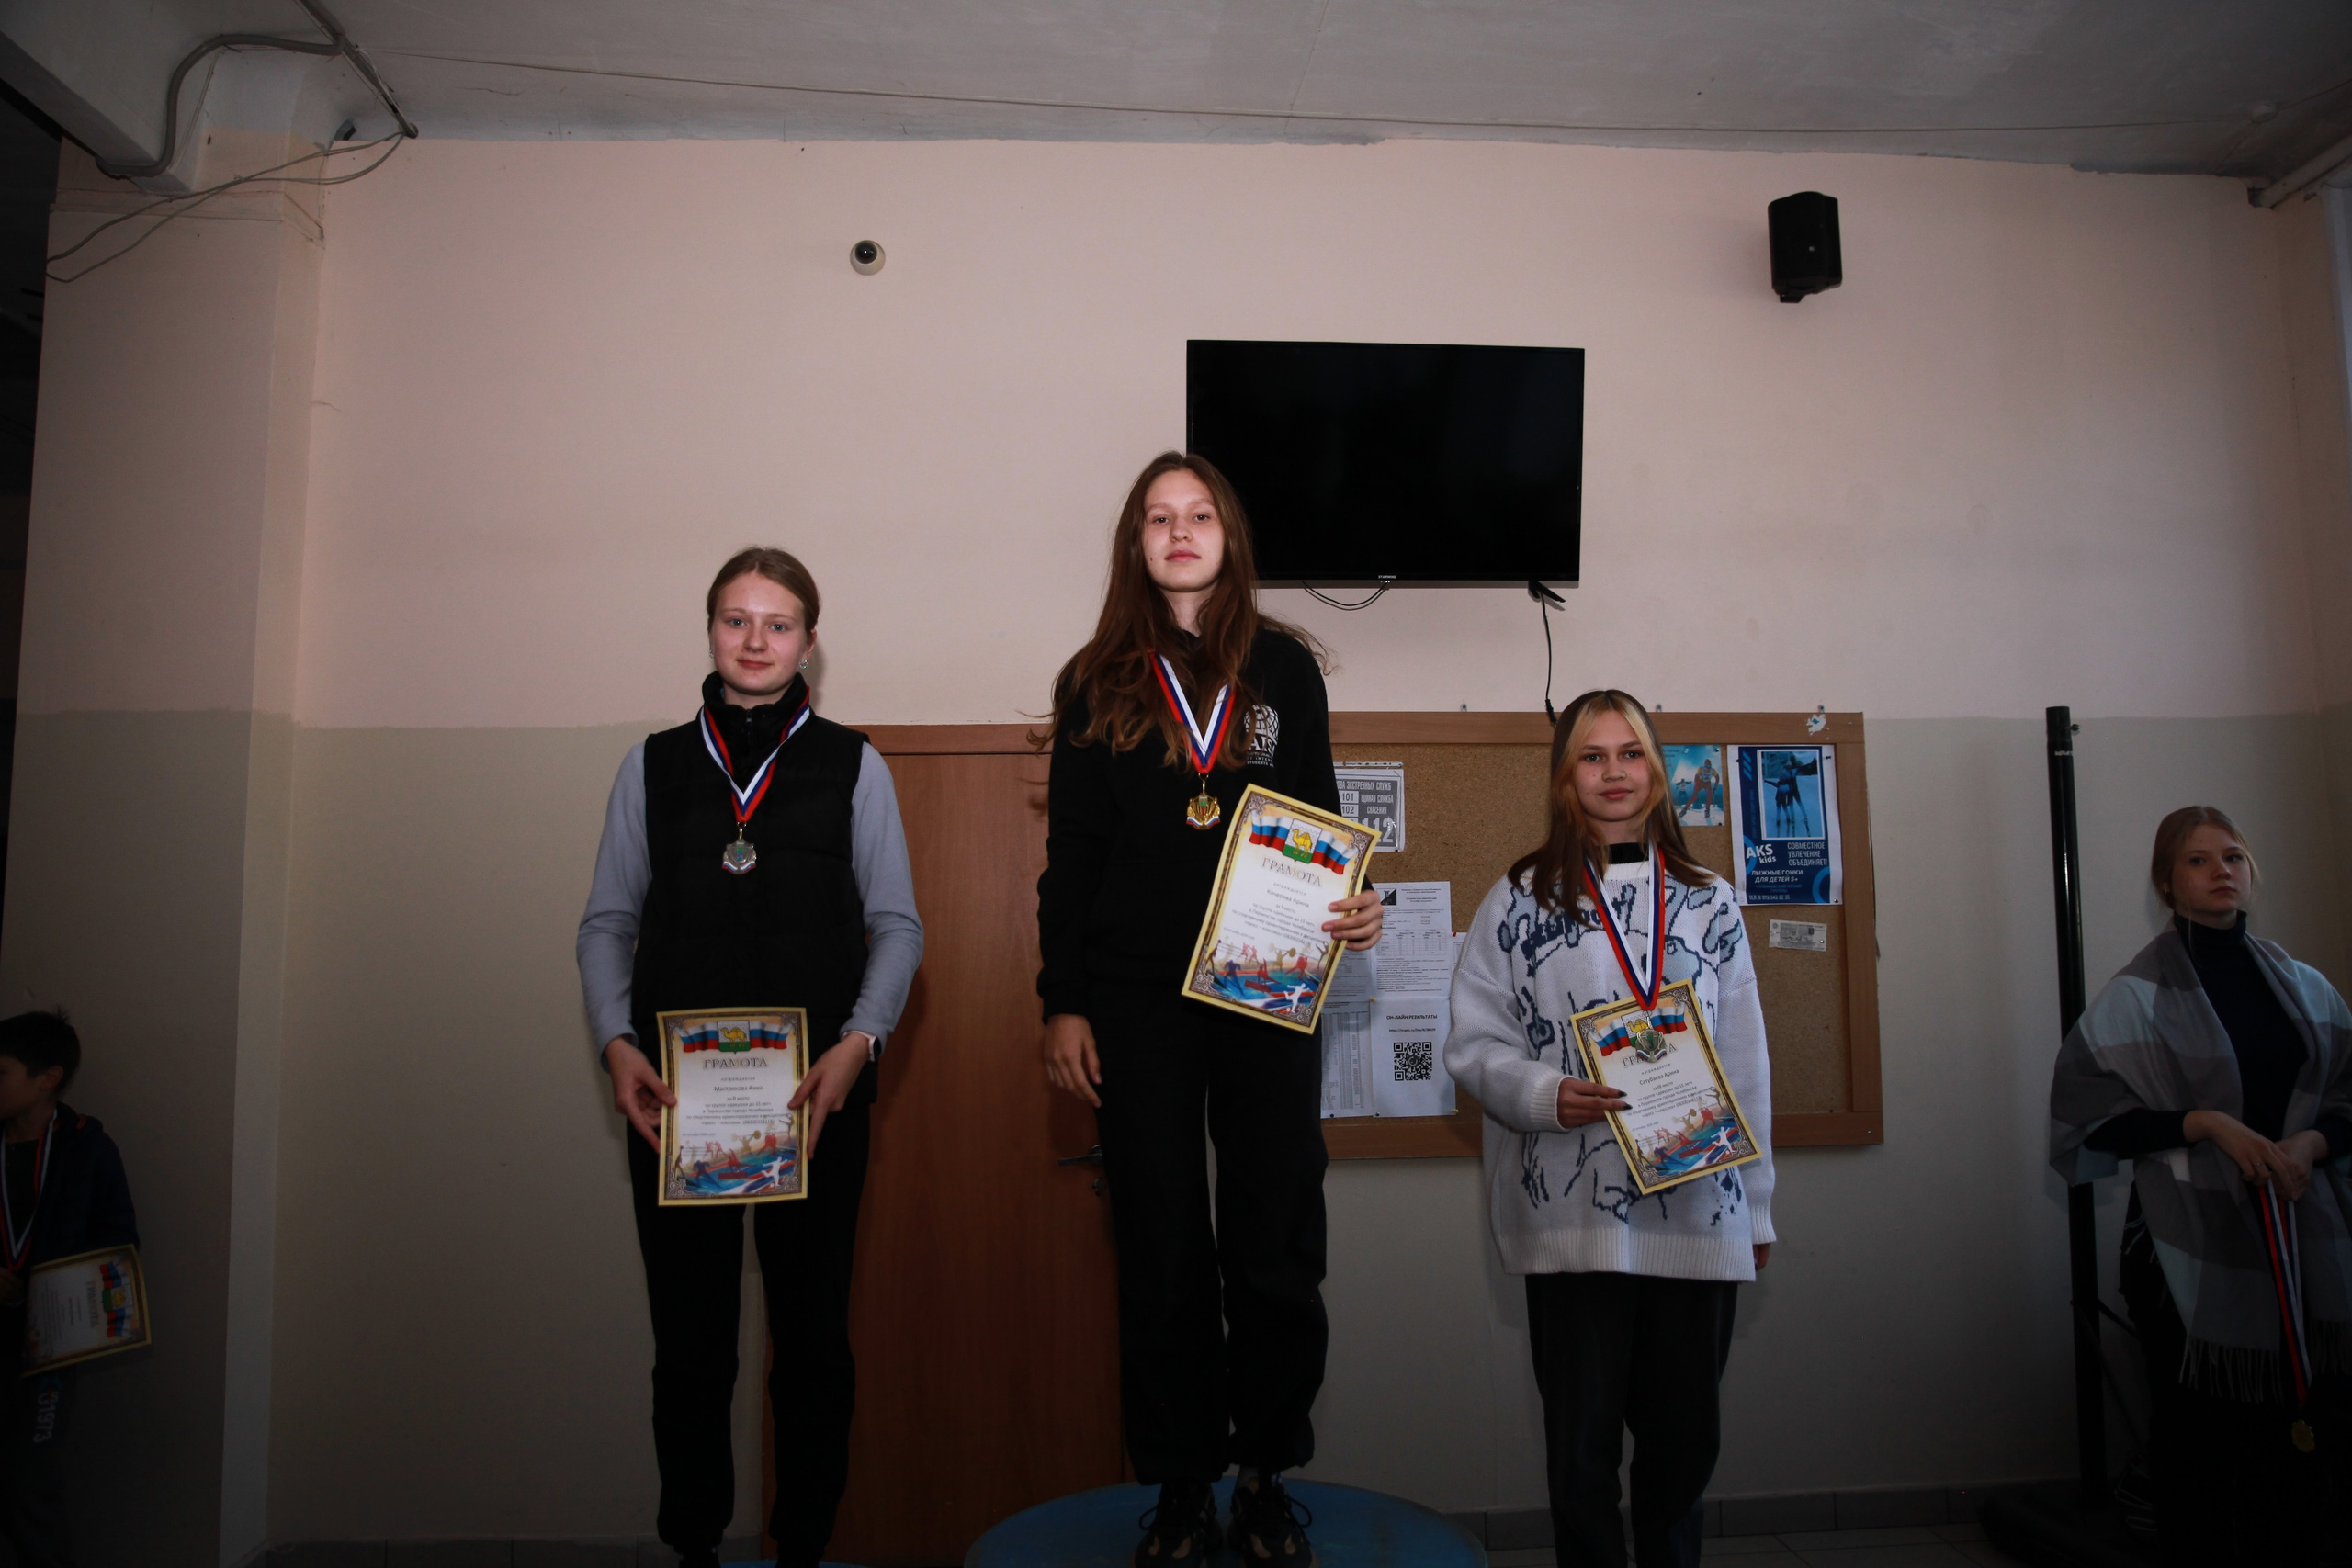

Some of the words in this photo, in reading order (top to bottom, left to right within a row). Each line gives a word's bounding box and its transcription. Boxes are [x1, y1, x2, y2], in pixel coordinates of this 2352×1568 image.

[1376, 782, 1391, 790] СЛУЖБ
[1342, 793, 1353, 801] 101
[1377, 795, 1394, 803] СЛУЖБА
[1342, 806, 1354, 814] 102
[1746, 844, 1773, 859] AKS
[1261, 858, 1323, 886] ГРАМОТА
[1622, 1043, 1677, 1067] ГРАА
[704, 1057, 768, 1069] ГРАМОТА
[1664, 1068, 1679, 1077] Арина
